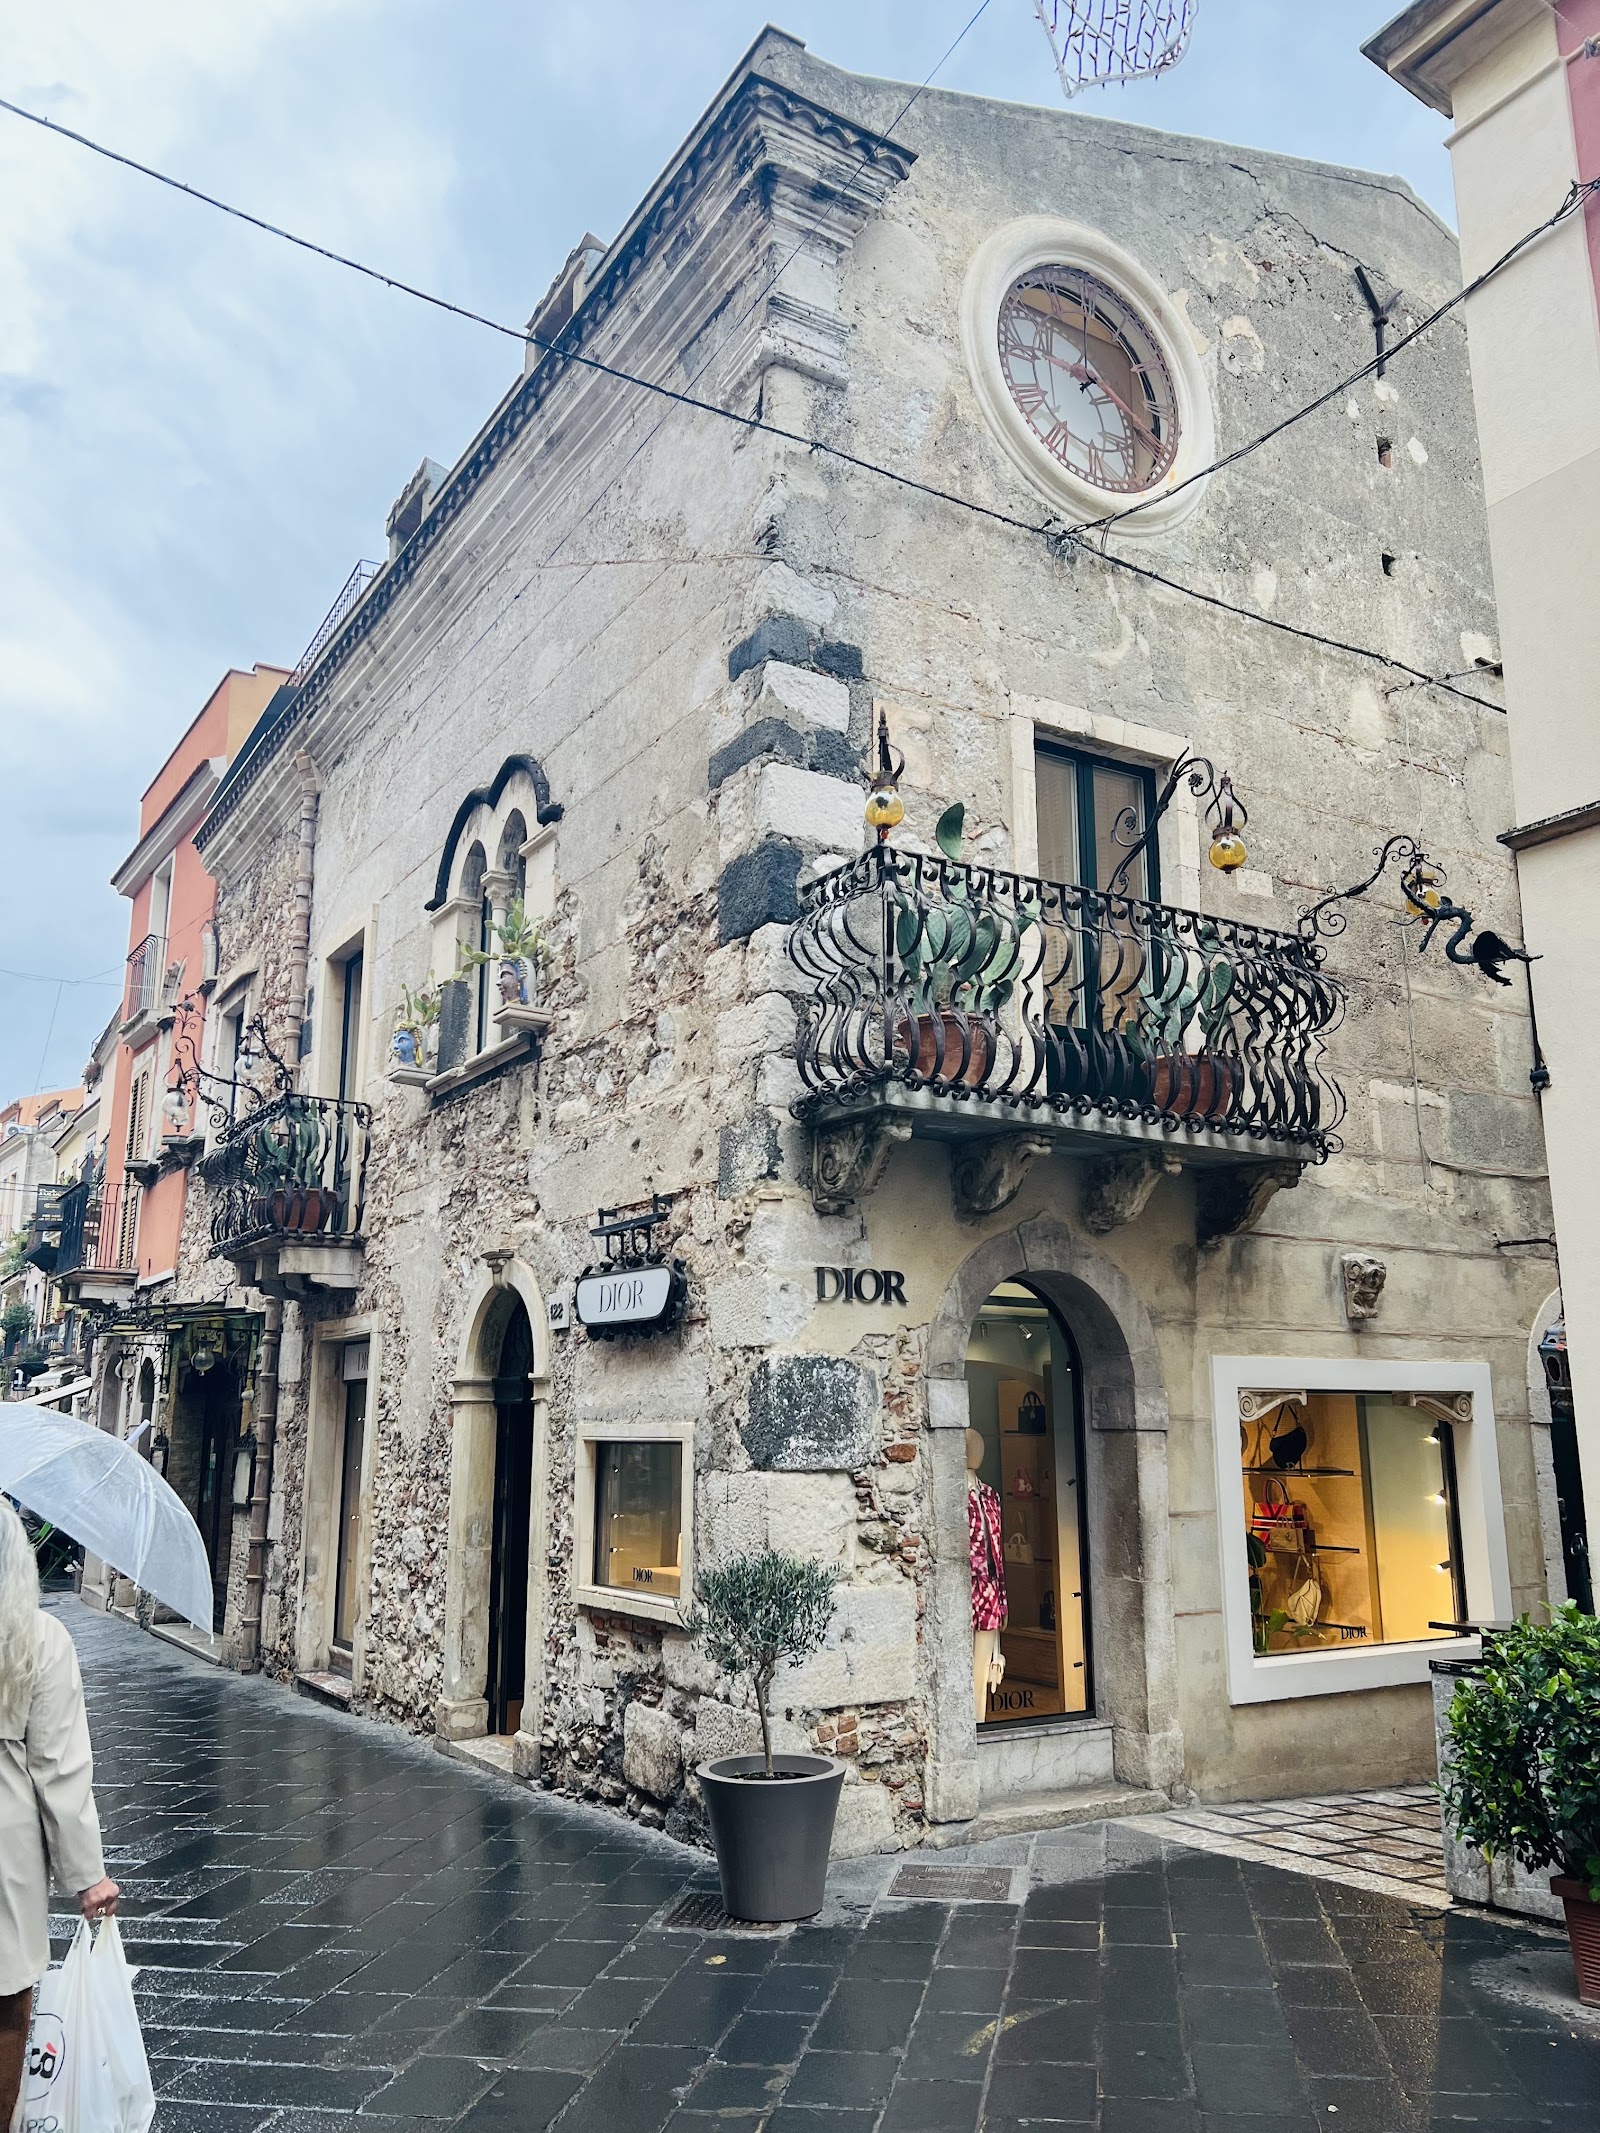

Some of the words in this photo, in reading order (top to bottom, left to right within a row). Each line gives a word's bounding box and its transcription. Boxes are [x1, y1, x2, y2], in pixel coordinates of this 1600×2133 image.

[599, 1279, 644, 1313] DIOR
[814, 1266, 909, 1305] DIOR
[550, 1302, 564, 1321] 122
[632, 1566, 653, 1583] DIOR
[1341, 1626, 1367, 1640] DIOR
[991, 1689, 1035, 1712] DIOR
